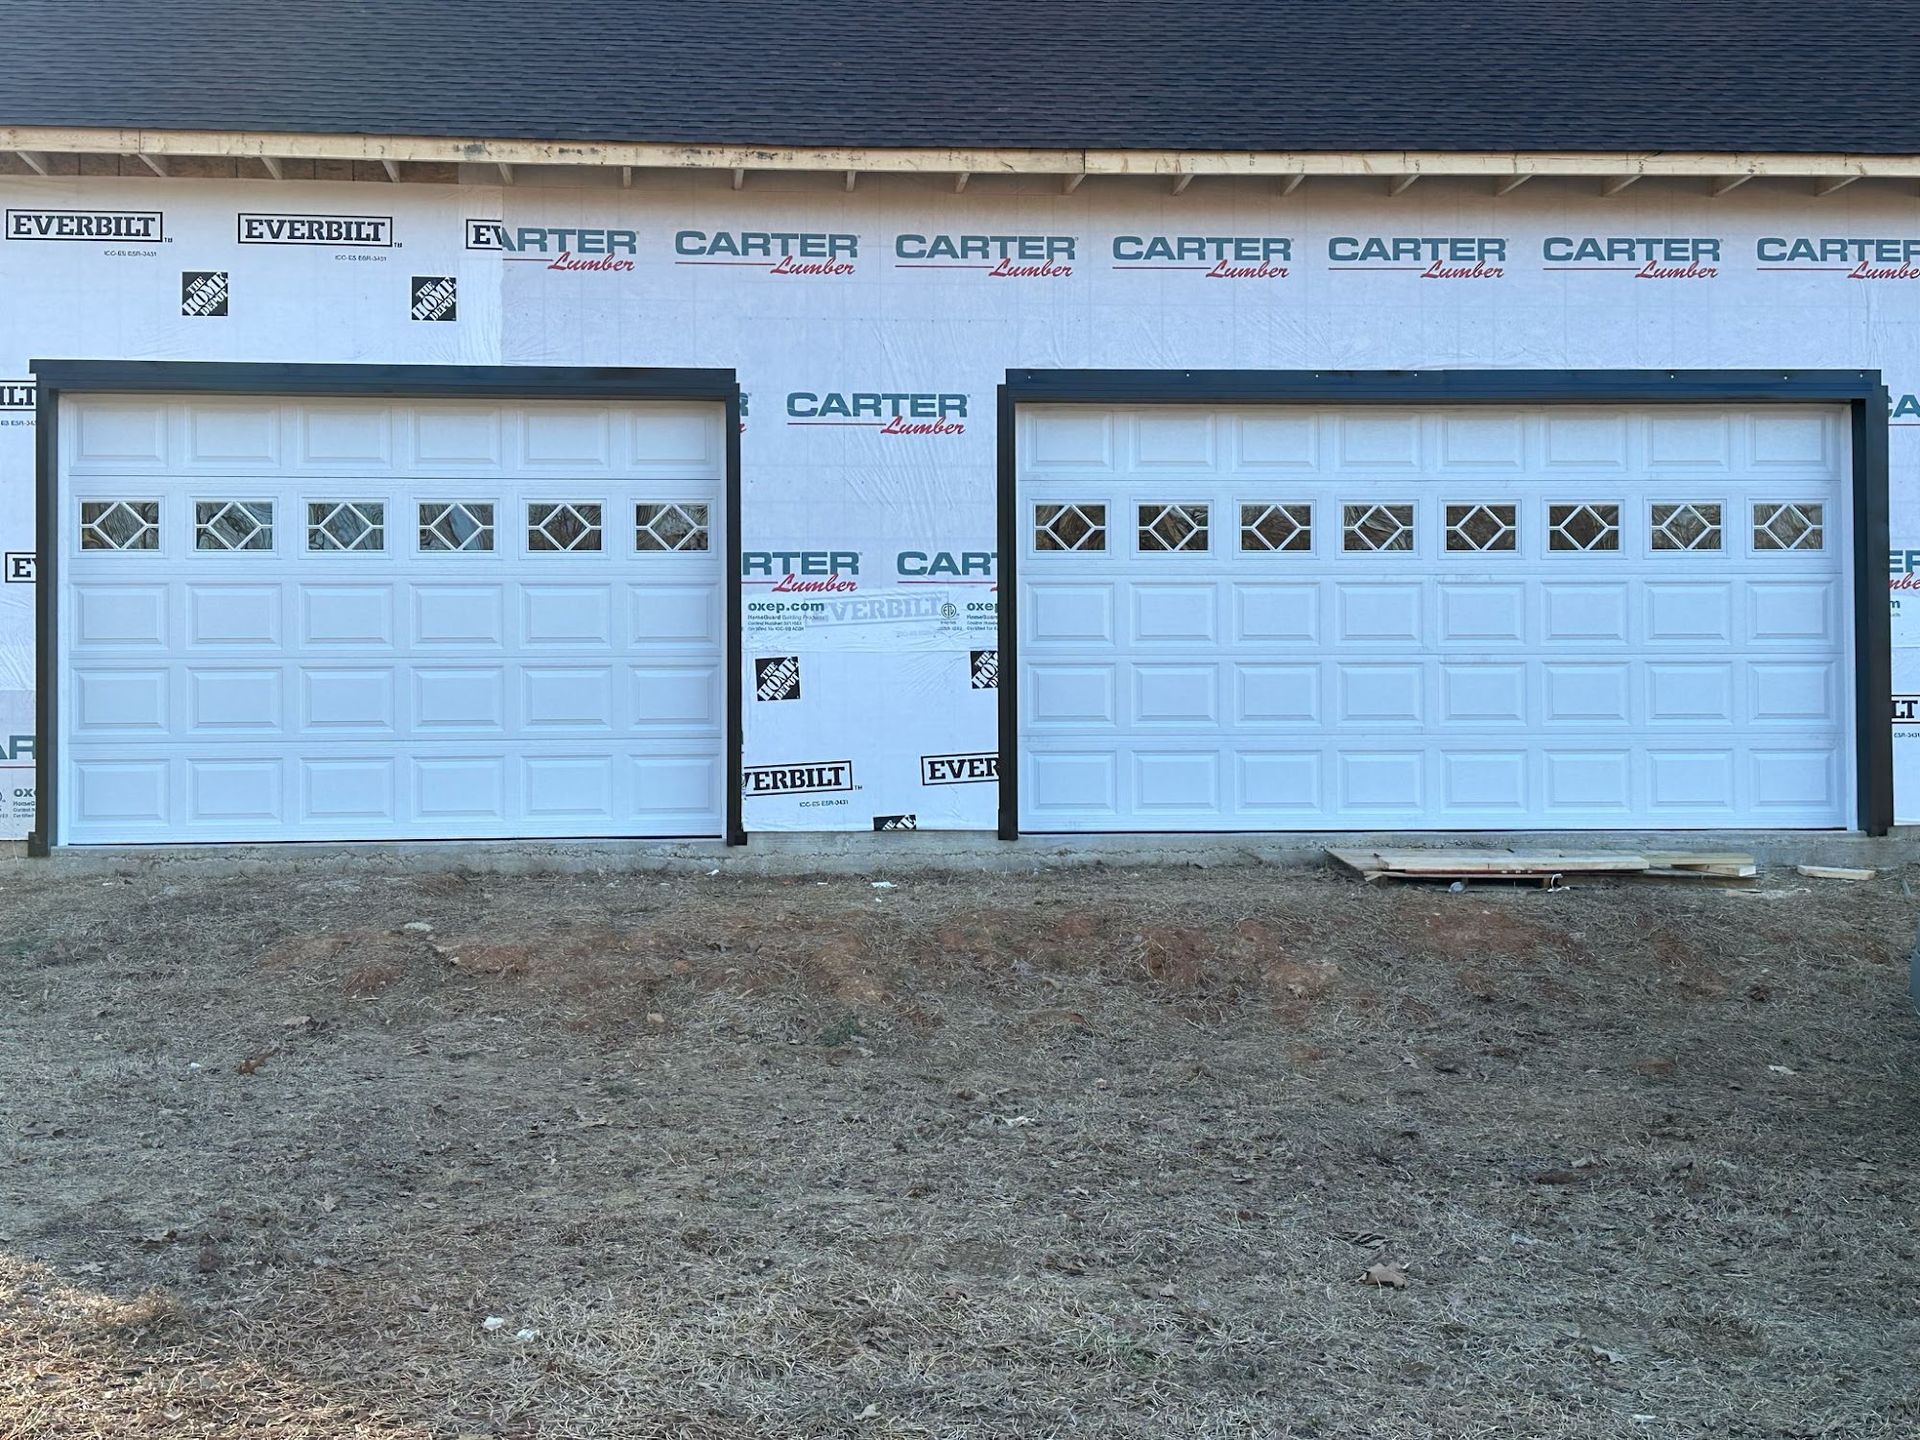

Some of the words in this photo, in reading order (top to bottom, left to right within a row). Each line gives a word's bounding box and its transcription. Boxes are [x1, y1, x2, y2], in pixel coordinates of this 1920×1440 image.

[13, 214, 156, 237] EVERBILT
[245, 218, 385, 242] EVERBILT
[675, 229, 858, 258] CARTER
[895, 234, 1075, 260] CARTER
[1113, 235, 1291, 261] CARTER
[1328, 236, 1505, 261] CARTER
[1543, 237, 1719, 262] CARTER
[547, 251, 635, 271] Lumber
[770, 255, 855, 275] Lumber
[988, 257, 1072, 278] Lumber
[1205, 258, 1289, 278] Lumber
[1420, 259, 1504, 279] Lumber
[1635, 259, 1718, 279] Lumber
[182, 271, 228, 316] HOME
[186, 275, 206, 294] THE
[415, 281, 435, 299] THE
[200, 288, 228, 316] DEPOT
[412, 276, 456, 320] HOME
[429, 293, 456, 320] DEPOT
[786, 392, 968, 418] CARTER
[880, 416, 966, 435] Lumber
[743, 552, 859, 576] RTER
[897, 551, 998, 576] CAR
[772, 573, 858, 592] Lumber
[748, 602, 825, 613] oxep.com
[757, 656, 799, 700] HOME
[760, 661, 778, 679] THE
[774, 671, 799, 700] DEPOT
